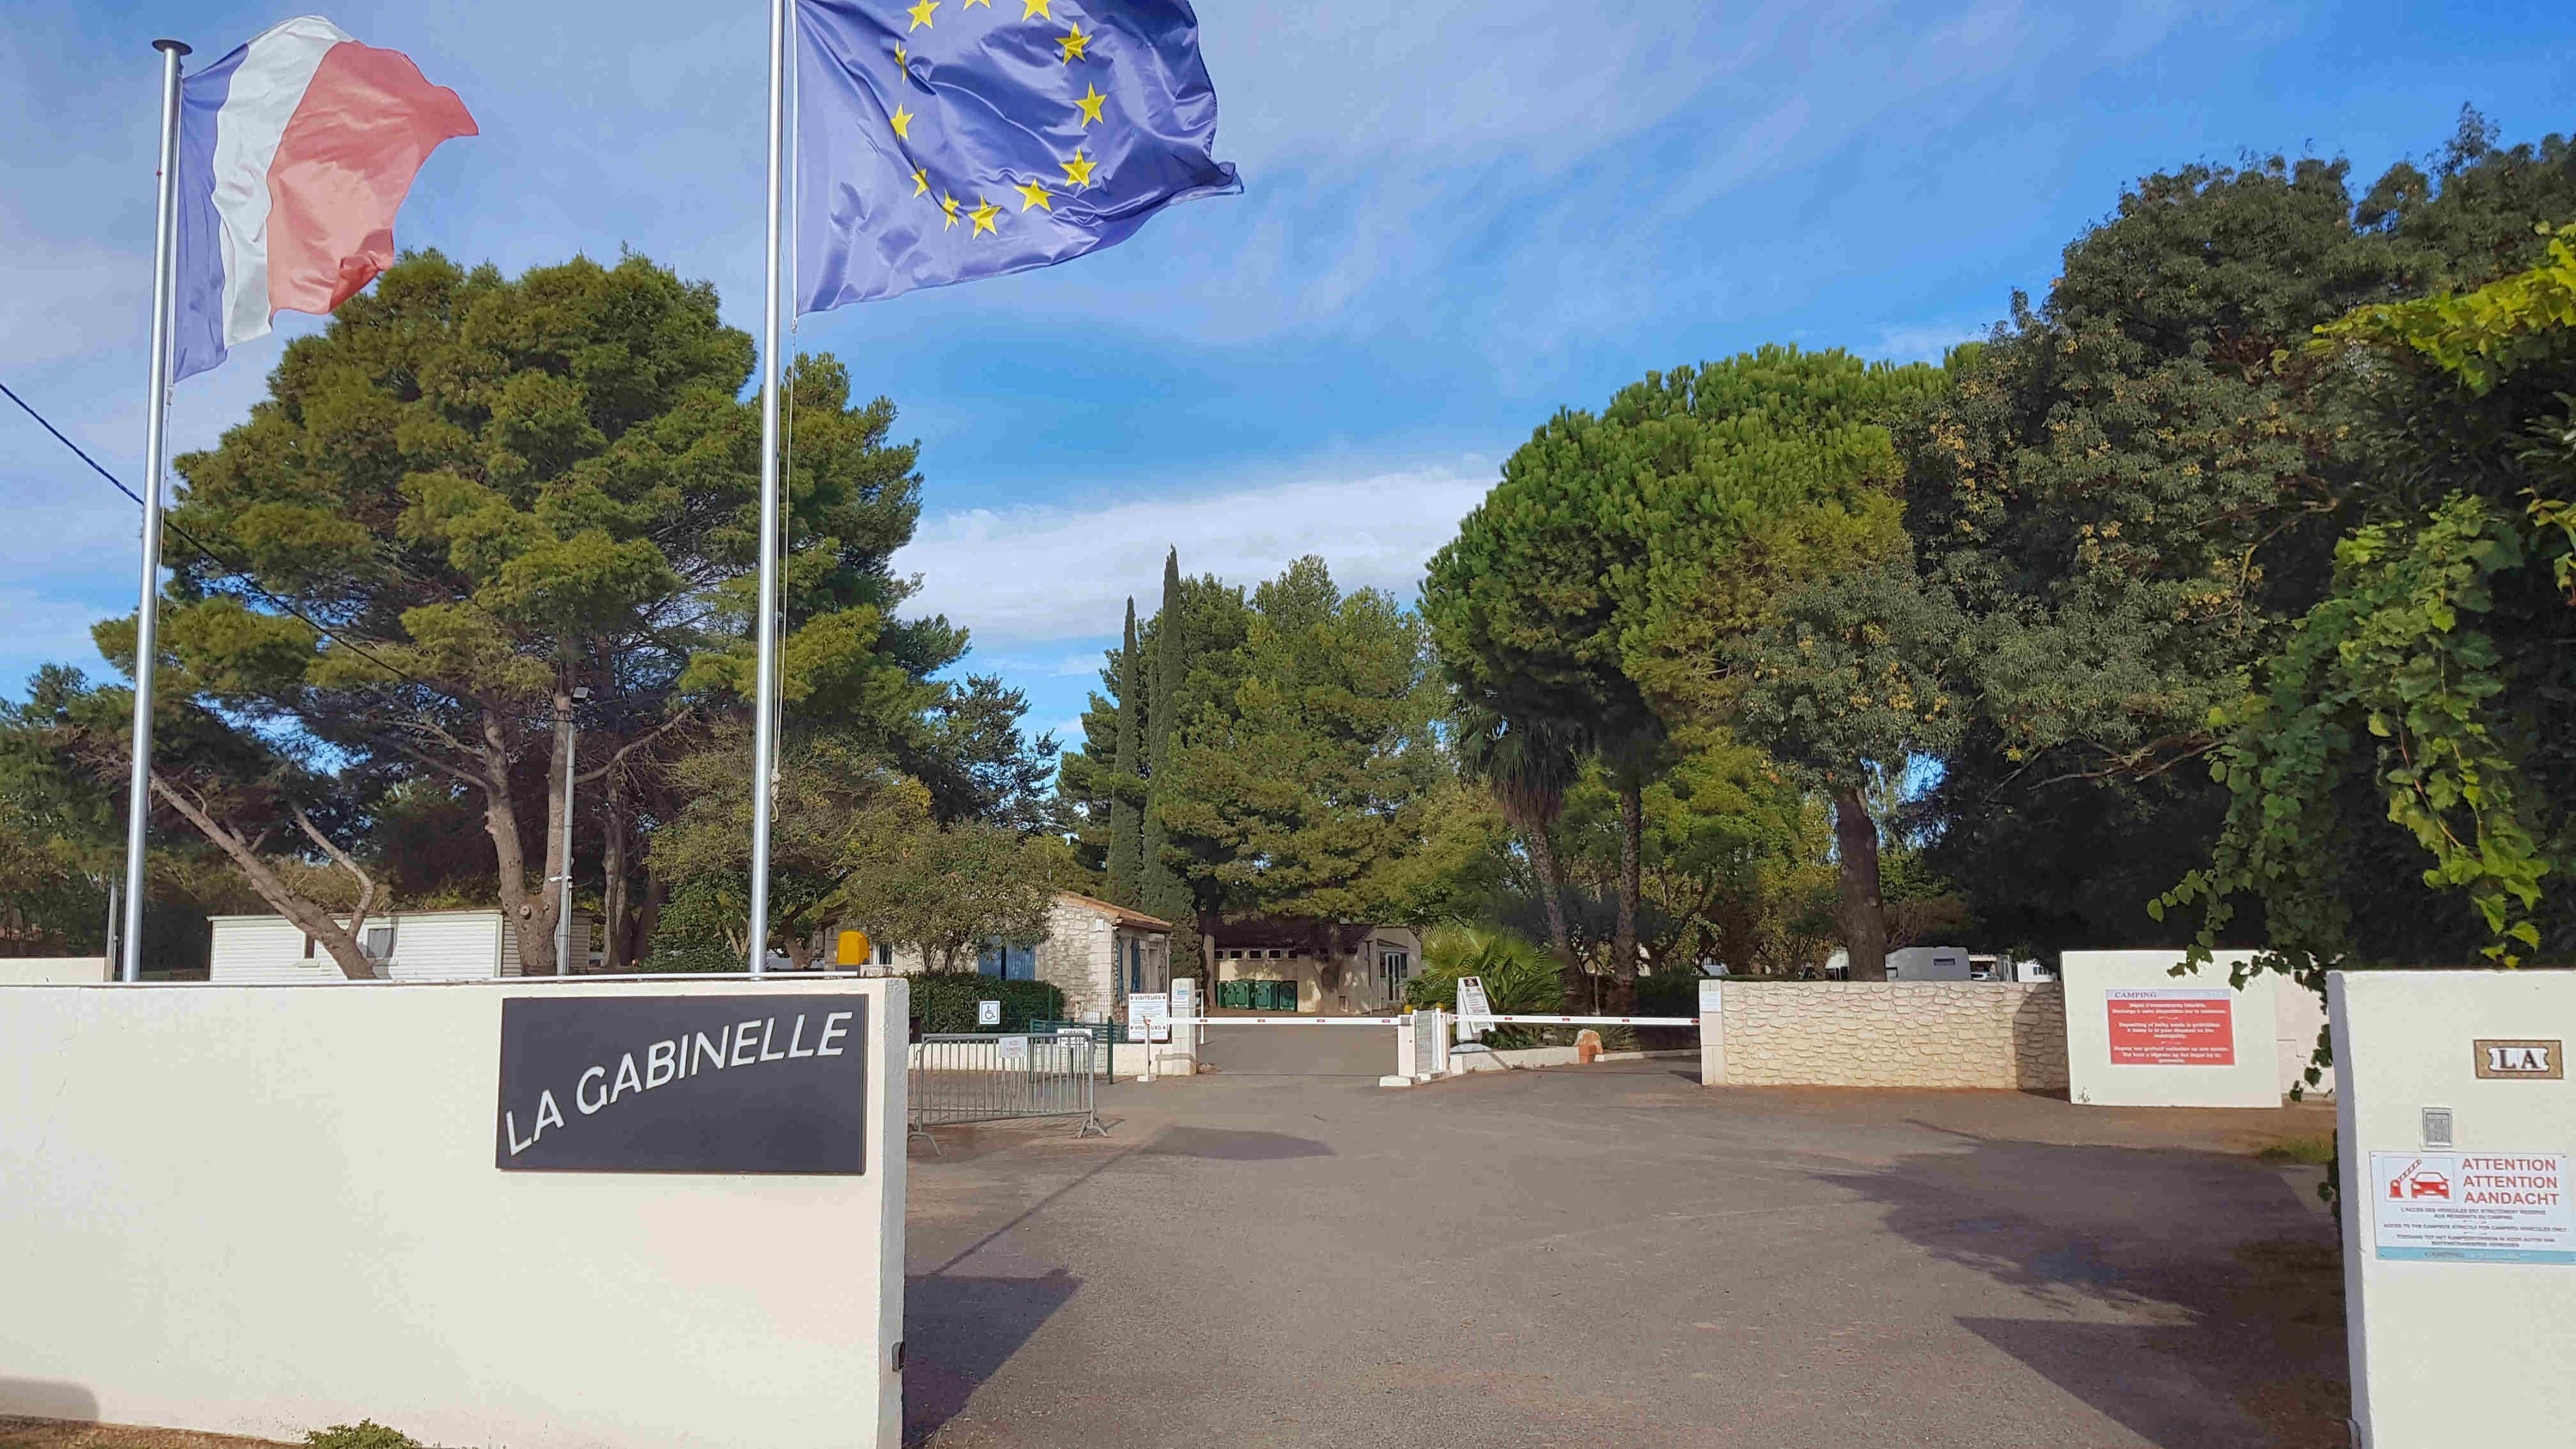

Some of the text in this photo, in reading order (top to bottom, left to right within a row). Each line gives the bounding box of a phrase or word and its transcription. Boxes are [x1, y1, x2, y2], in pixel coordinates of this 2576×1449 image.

[2498, 1050, 2541, 1069] LA
[505, 1011, 854, 1156] LA GABINELLE
[2462, 1158, 2556, 1172] ATTENTION
[2463, 1175, 2558, 1189] ATTENTION
[2464, 1192, 2560, 1205] AANDACHT
